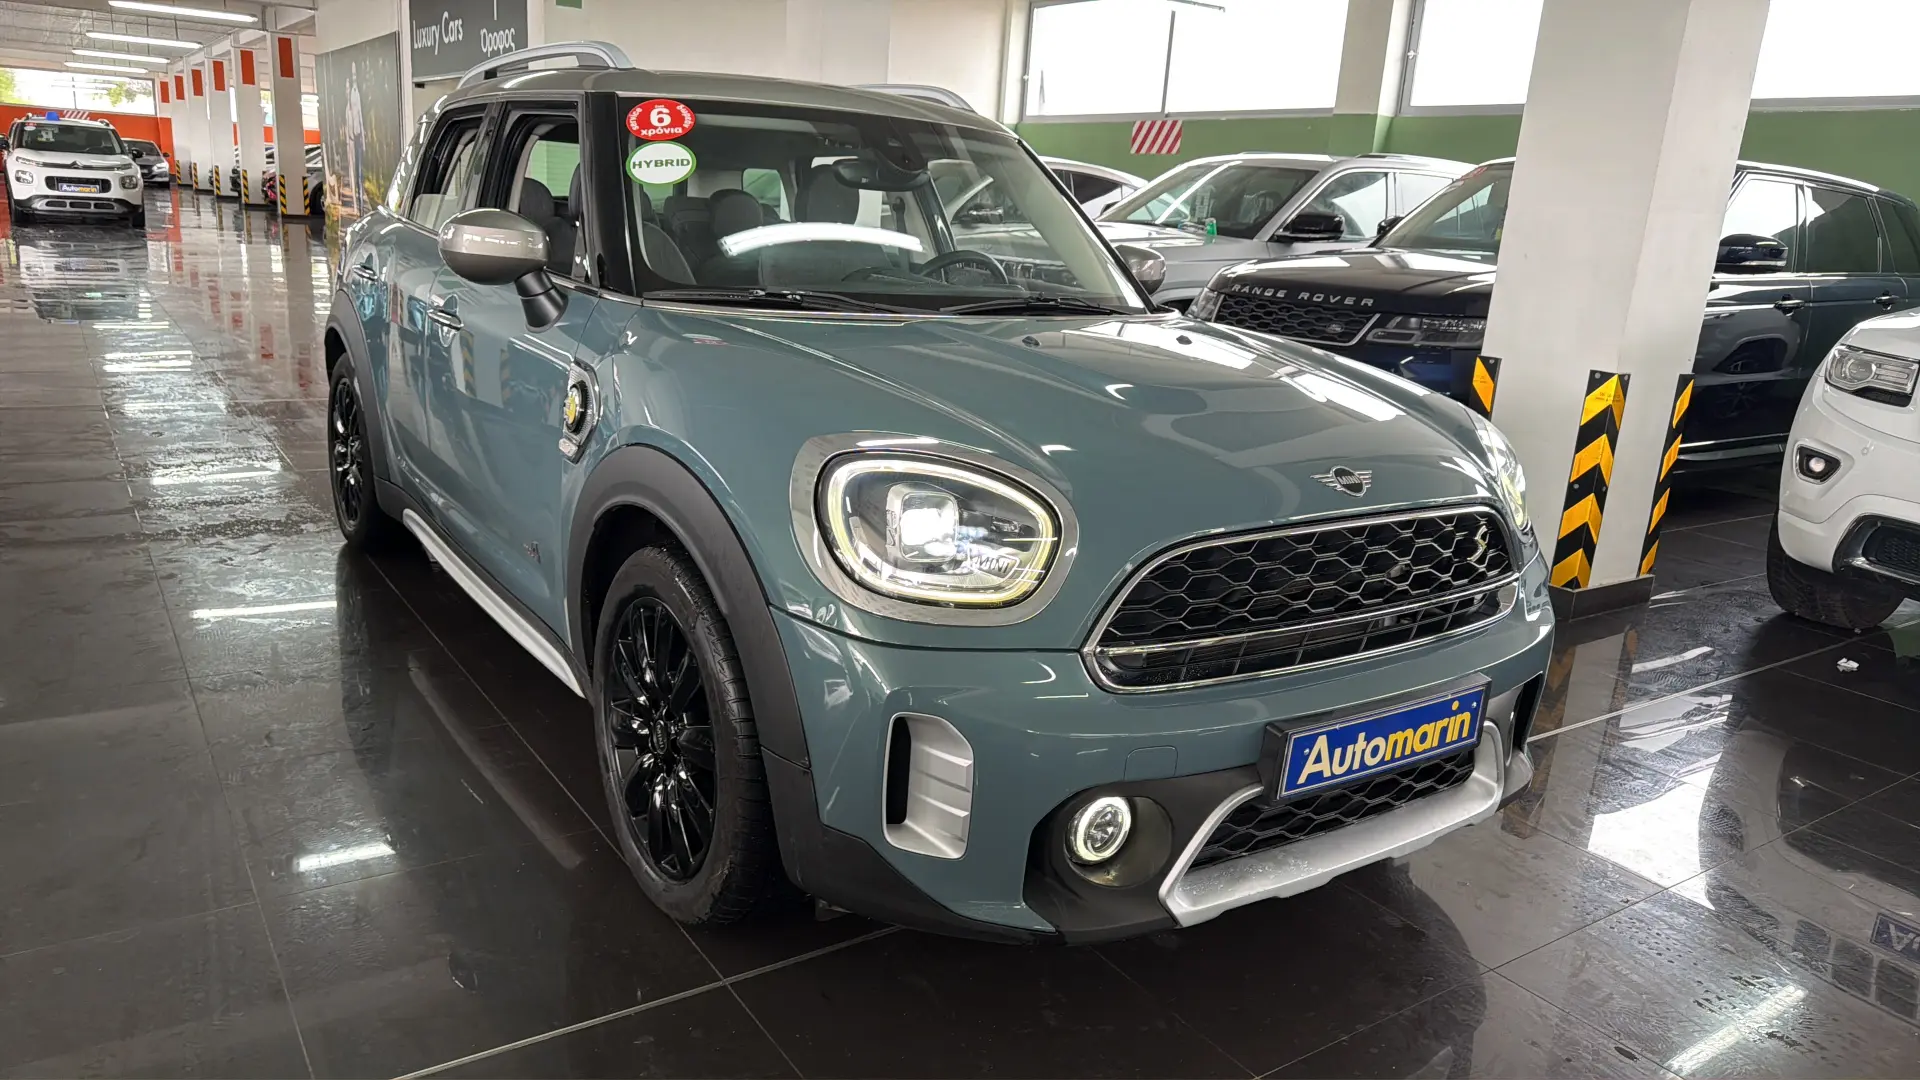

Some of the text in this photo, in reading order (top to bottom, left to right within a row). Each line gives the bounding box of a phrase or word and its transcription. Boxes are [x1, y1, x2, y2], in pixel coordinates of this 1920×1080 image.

[413, 11, 463, 55] Luxury Cars
[649, 107, 672, 127] 6
[640, 126, 682, 137] χρόνια
[632, 158, 691, 169] HYBRID
[62, 184, 97, 193] Automarin
[1231, 284, 1374, 307] RANGE ROVER
[1297, 700, 1472, 785] Automarin
